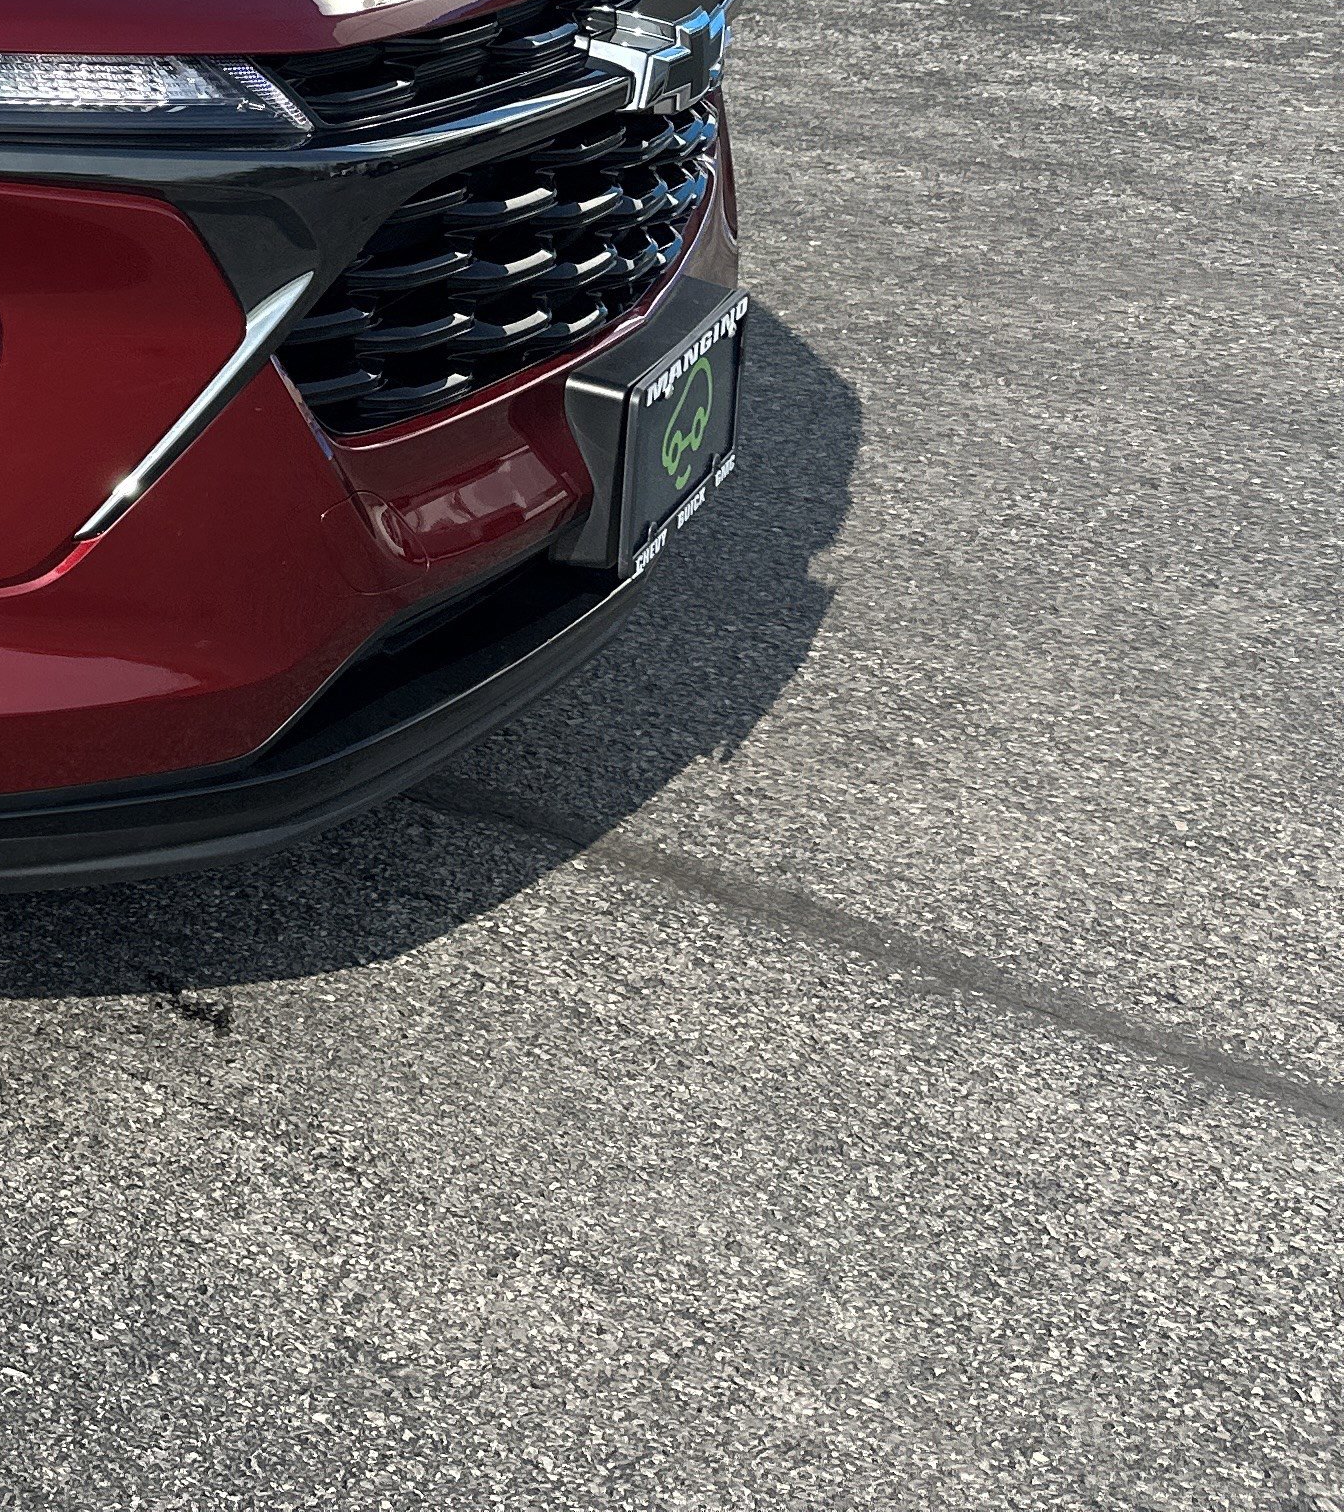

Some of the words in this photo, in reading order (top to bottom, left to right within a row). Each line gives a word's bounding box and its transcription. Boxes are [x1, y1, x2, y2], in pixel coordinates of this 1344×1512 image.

[646, 296, 748, 407] MANGINO
[634, 528, 668, 576] CHEVY
[677, 487, 706, 529] BUICK
[715, 454, 736, 487] GMC
